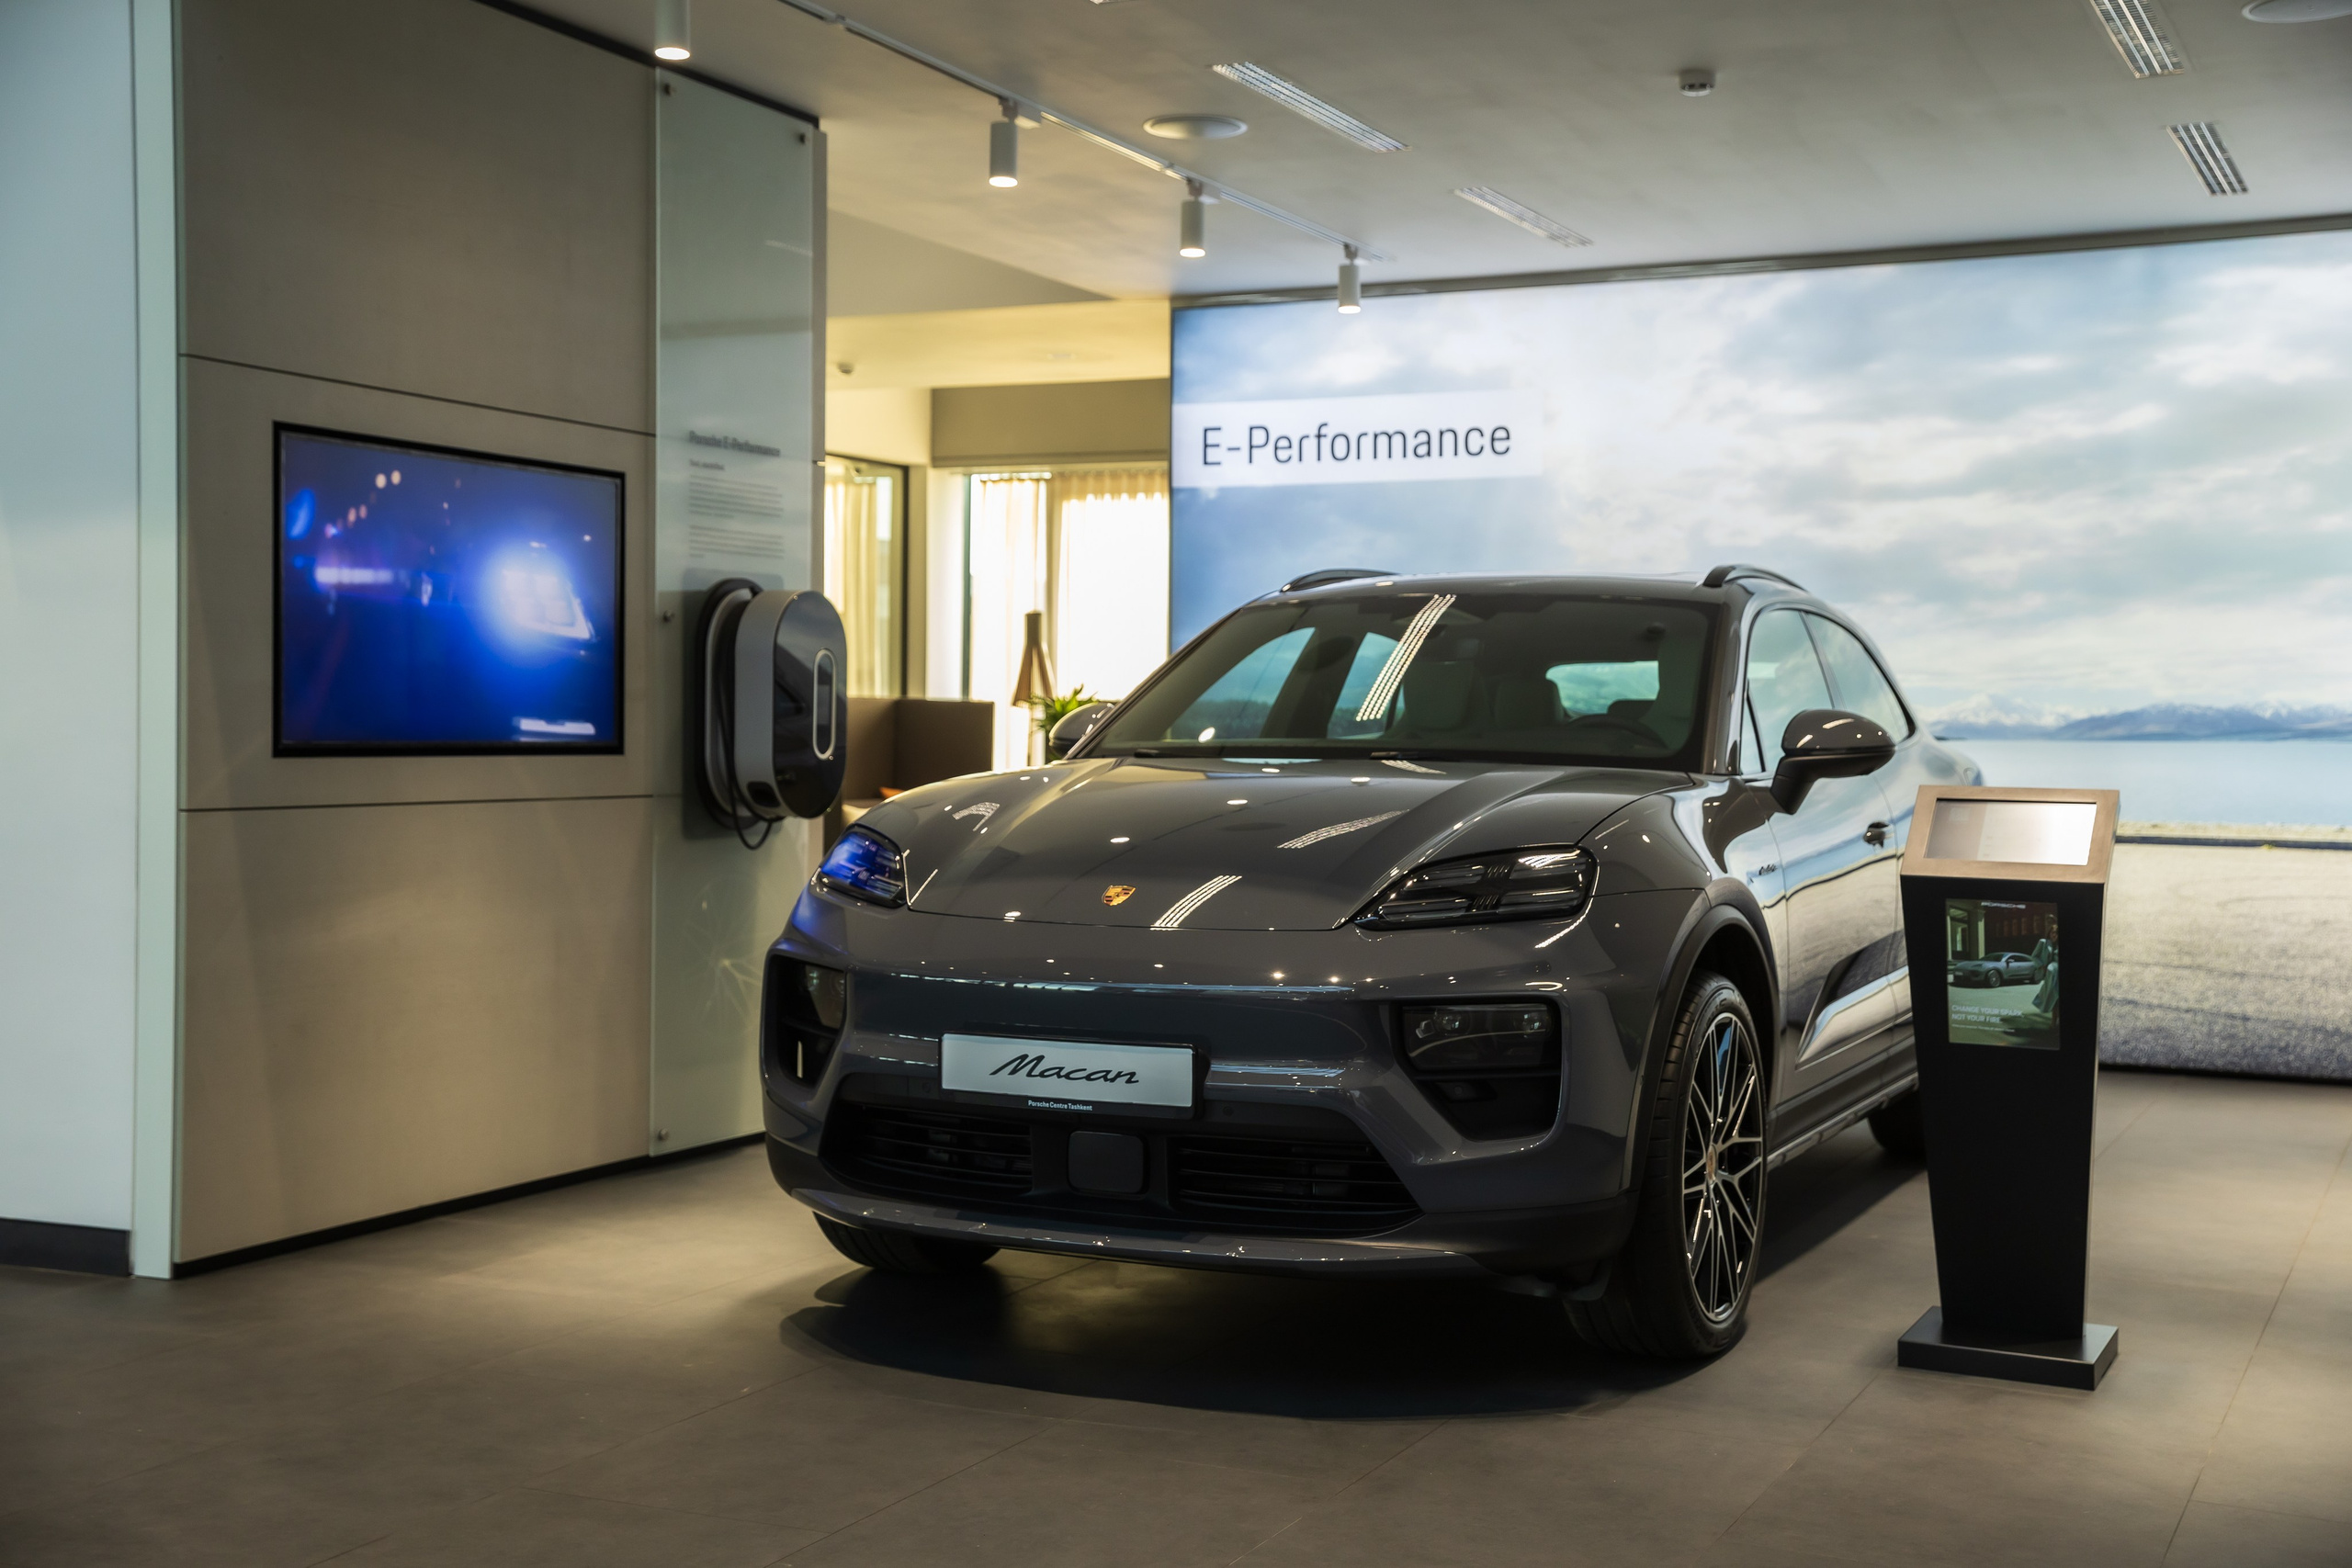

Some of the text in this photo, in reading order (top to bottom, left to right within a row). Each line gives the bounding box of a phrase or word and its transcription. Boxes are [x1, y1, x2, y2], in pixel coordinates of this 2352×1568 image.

[1202, 423, 1511, 466] E-Performance
[989, 1053, 1139, 1085] Macan
[1028, 1100, 1093, 1111] Porsche Centre Tashkent
